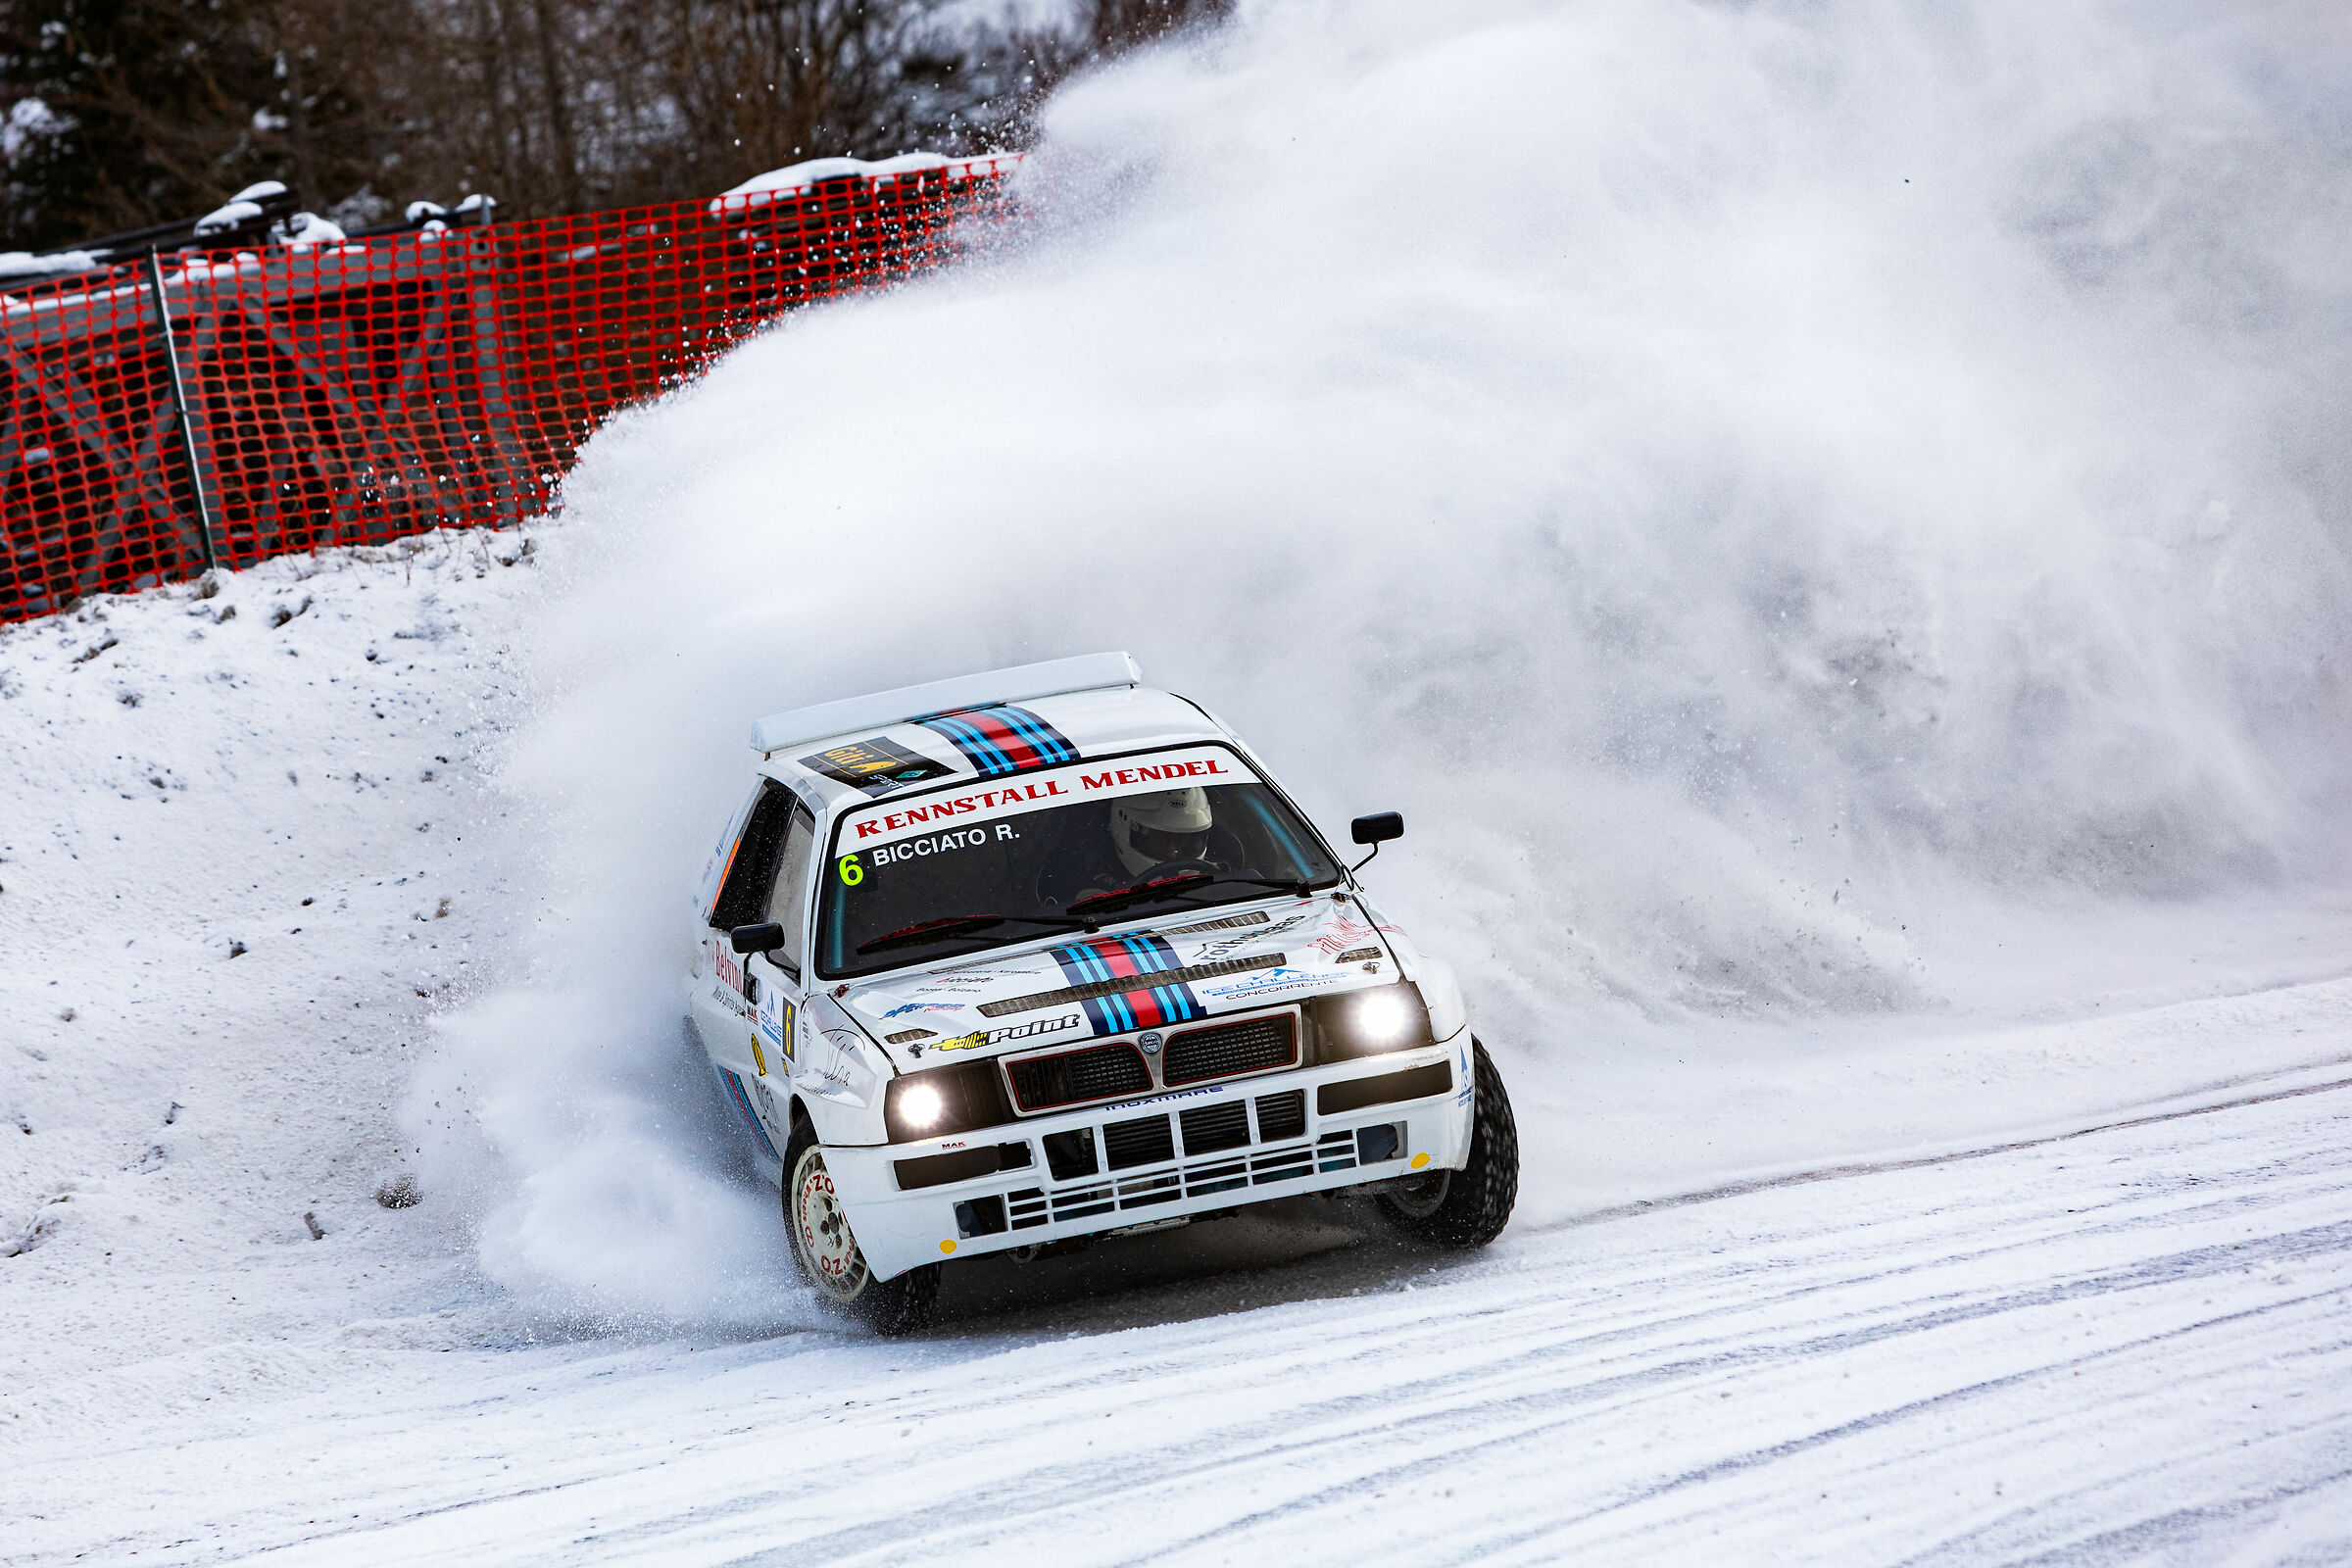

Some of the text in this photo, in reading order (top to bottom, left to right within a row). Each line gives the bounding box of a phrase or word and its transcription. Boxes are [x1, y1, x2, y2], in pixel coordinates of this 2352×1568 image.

[855, 760, 1229, 839] RENNSTALL MENDEL
[872, 823, 1020, 867] BICCIATO R.
[838, 854, 864, 887] 6
[1225, 980, 1341, 1000] CONCORRENTE
[785, 1004, 792, 1055] 6
[988, 1014, 1080, 1044] Point
